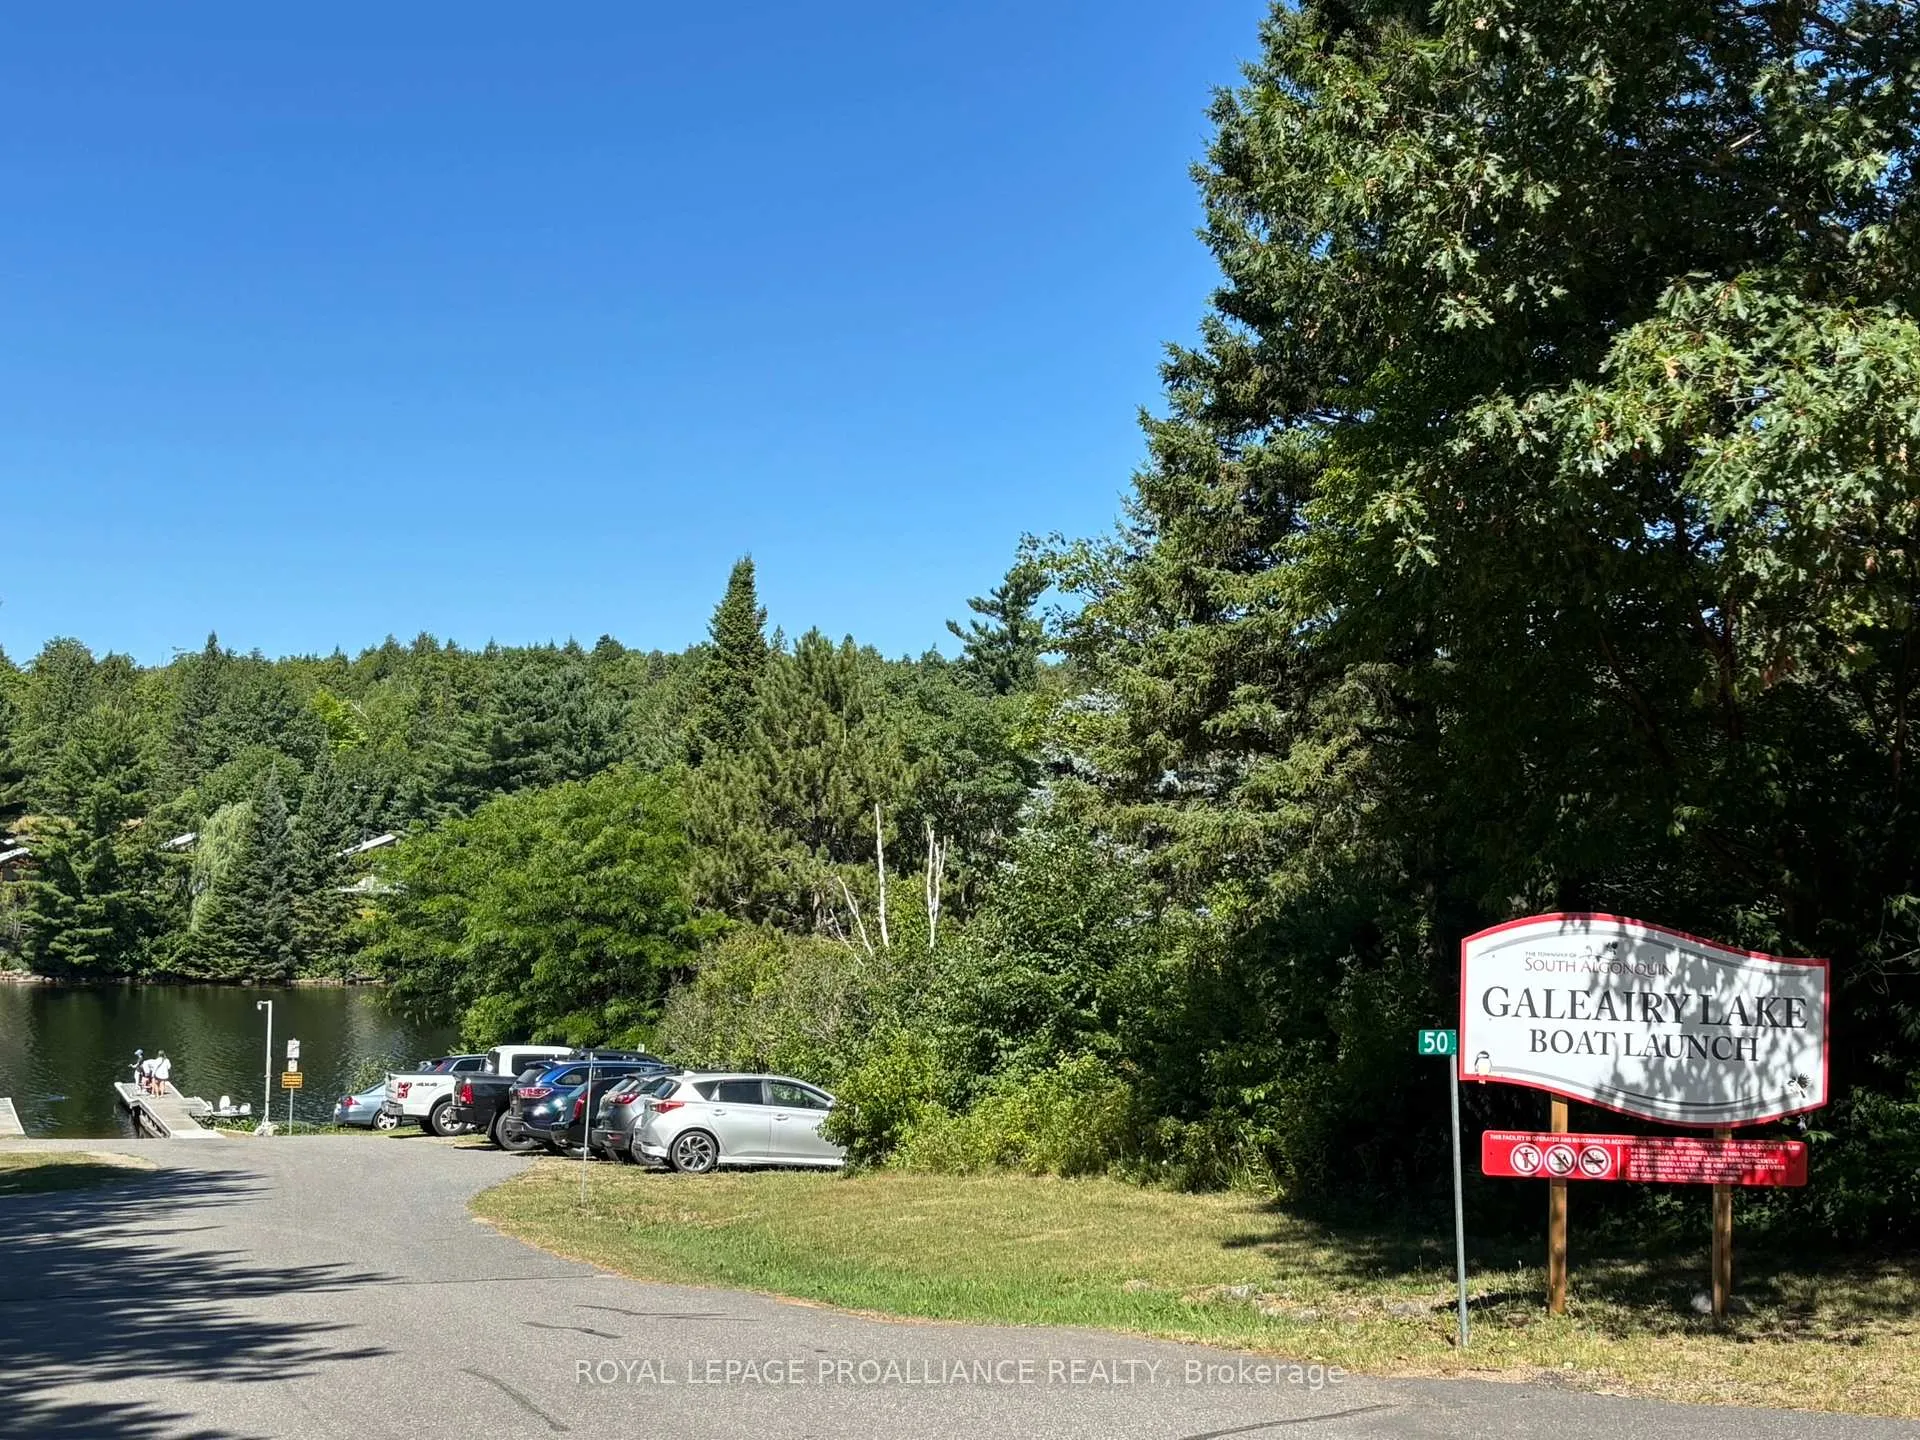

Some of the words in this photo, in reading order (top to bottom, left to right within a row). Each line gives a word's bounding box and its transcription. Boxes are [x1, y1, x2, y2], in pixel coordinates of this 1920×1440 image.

[1524, 956, 1577, 973] SOUTH
[1580, 960, 1673, 978] ALGONQUIN
[1482, 986, 1692, 1024] GALEAIRY
[1699, 994, 1808, 1029] LAKE
[1423, 1031, 1448, 1053] 50
[1529, 1028, 1616, 1056] BOAT
[1623, 1032, 1760, 1062] LAUNCH
